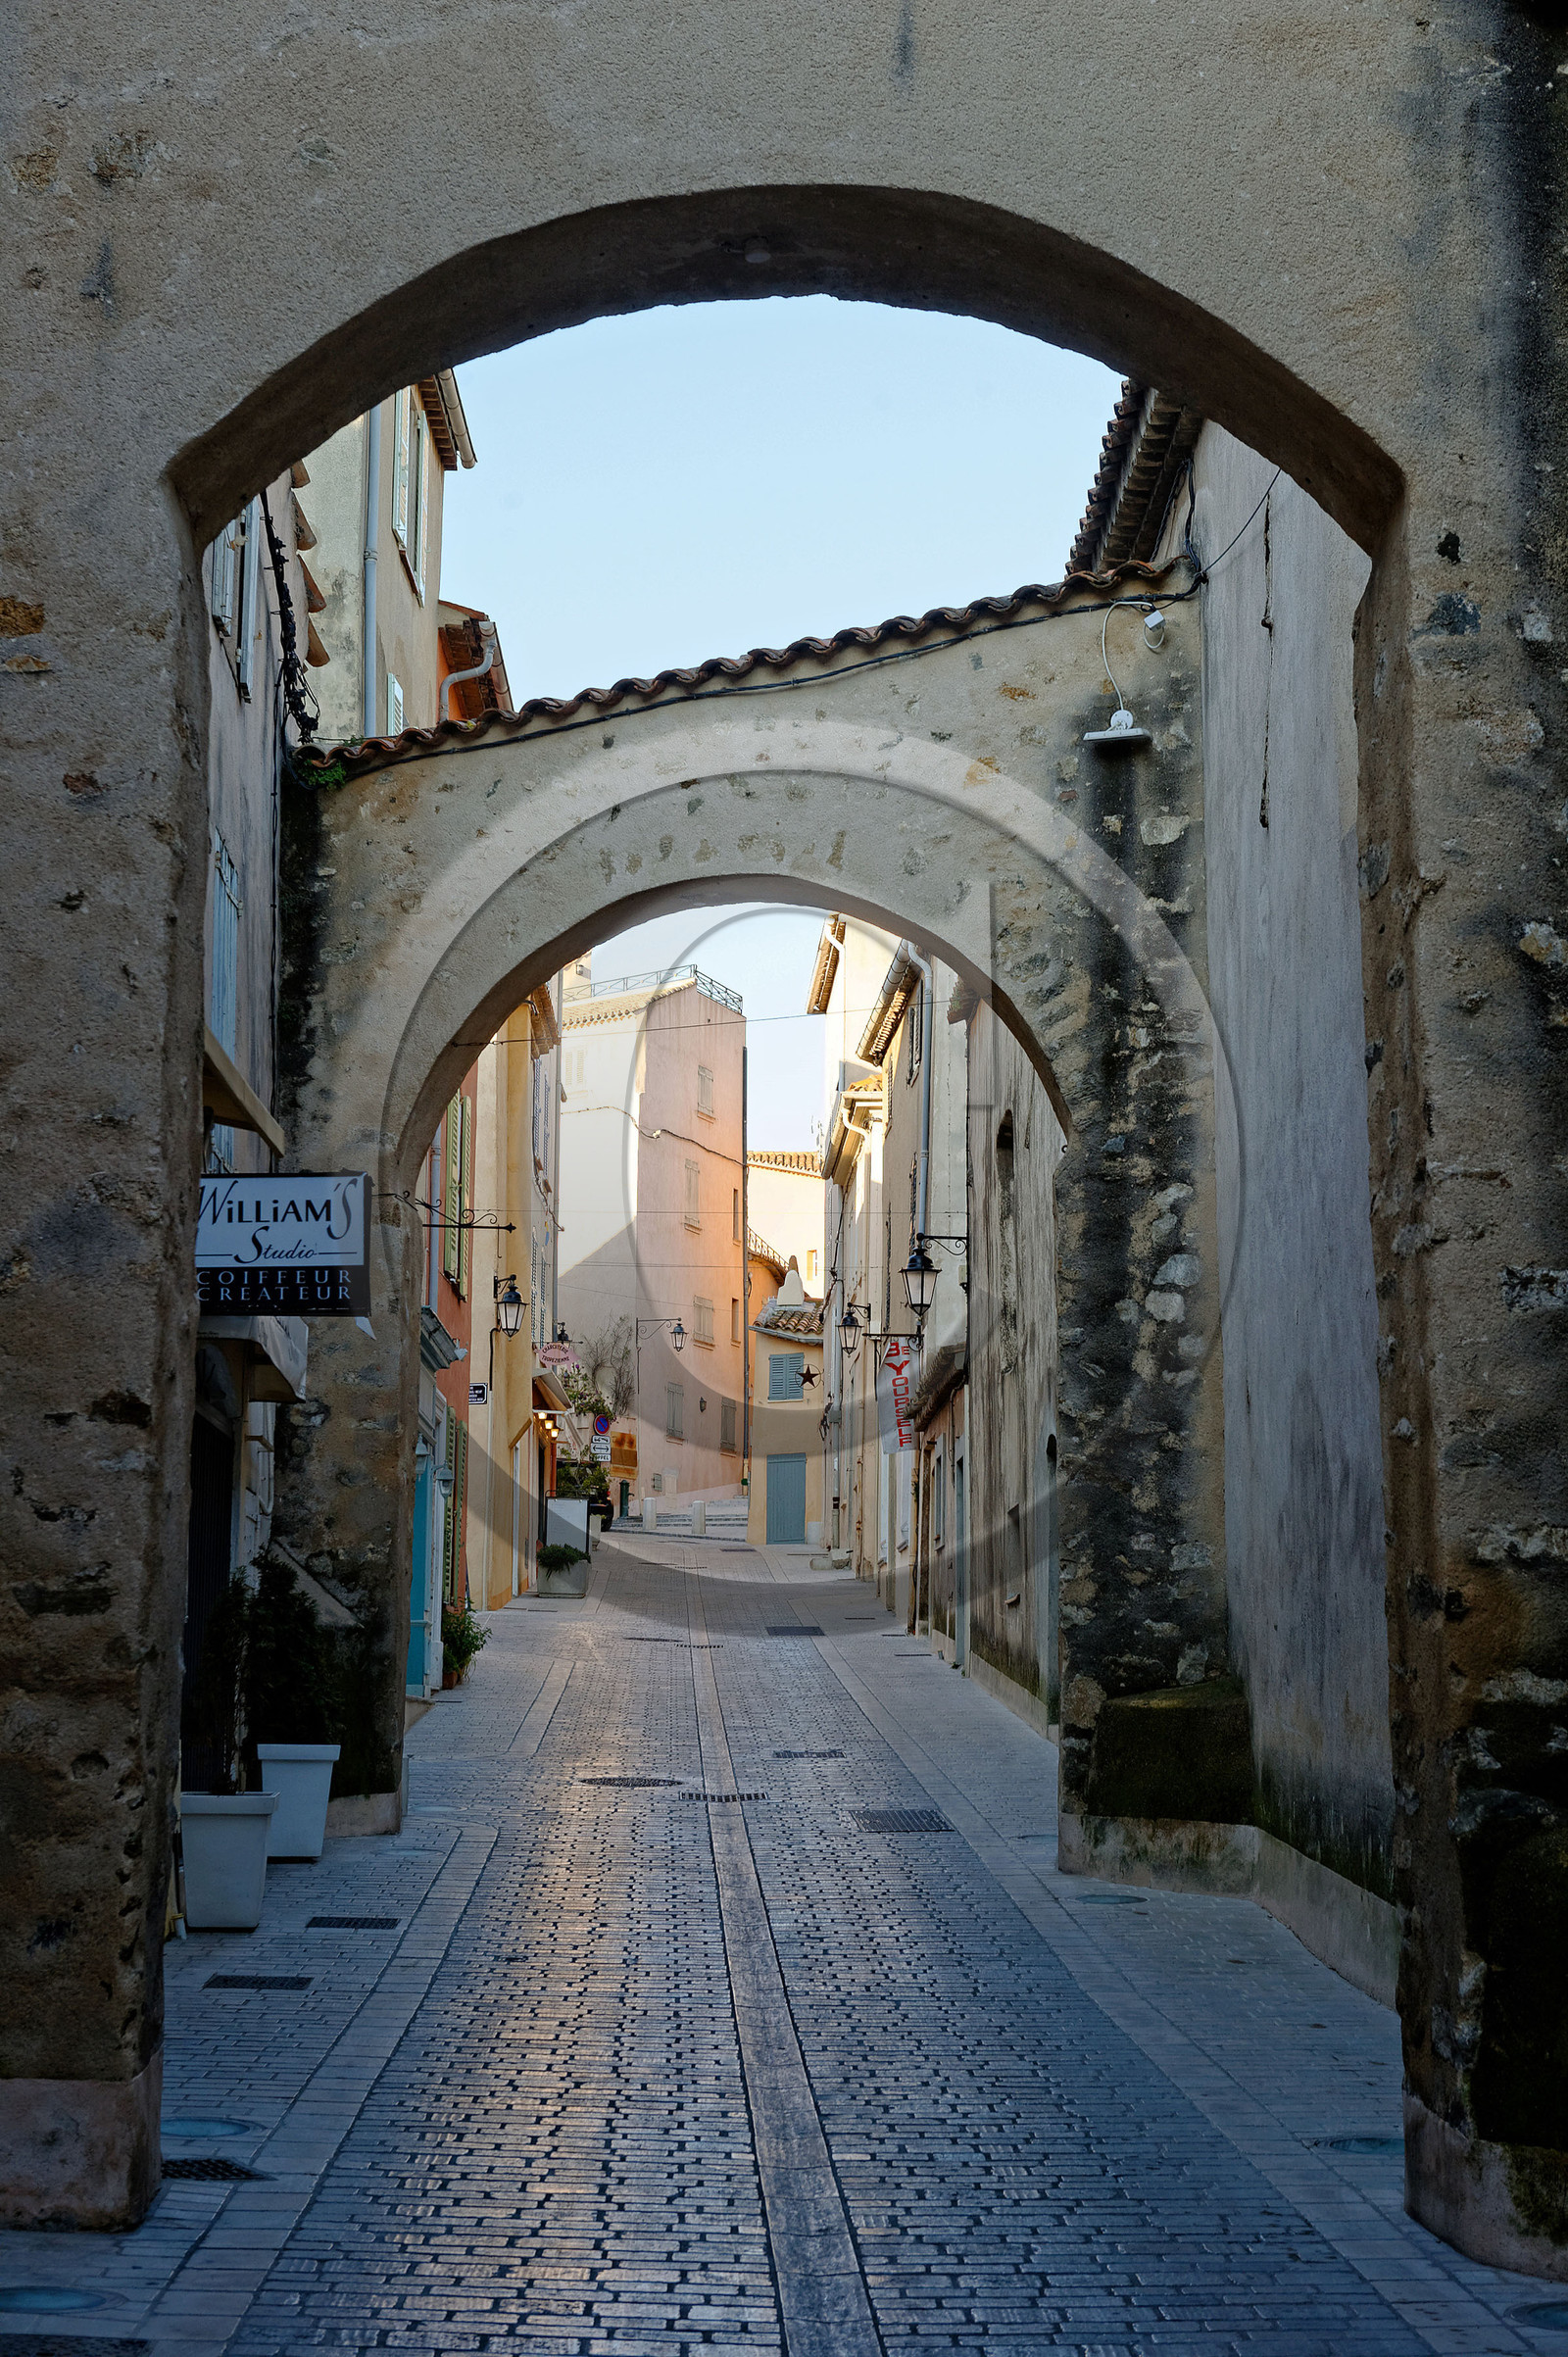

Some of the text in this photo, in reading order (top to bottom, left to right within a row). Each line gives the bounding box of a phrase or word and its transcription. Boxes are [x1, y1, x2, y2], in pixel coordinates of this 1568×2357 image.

[233, 1225, 318, 1264] Studio
[196, 1269, 352, 1286] COIFFEUR
[196, 1286, 352, 1301] CREATEUR
[886, 1342, 910, 1358] BE
